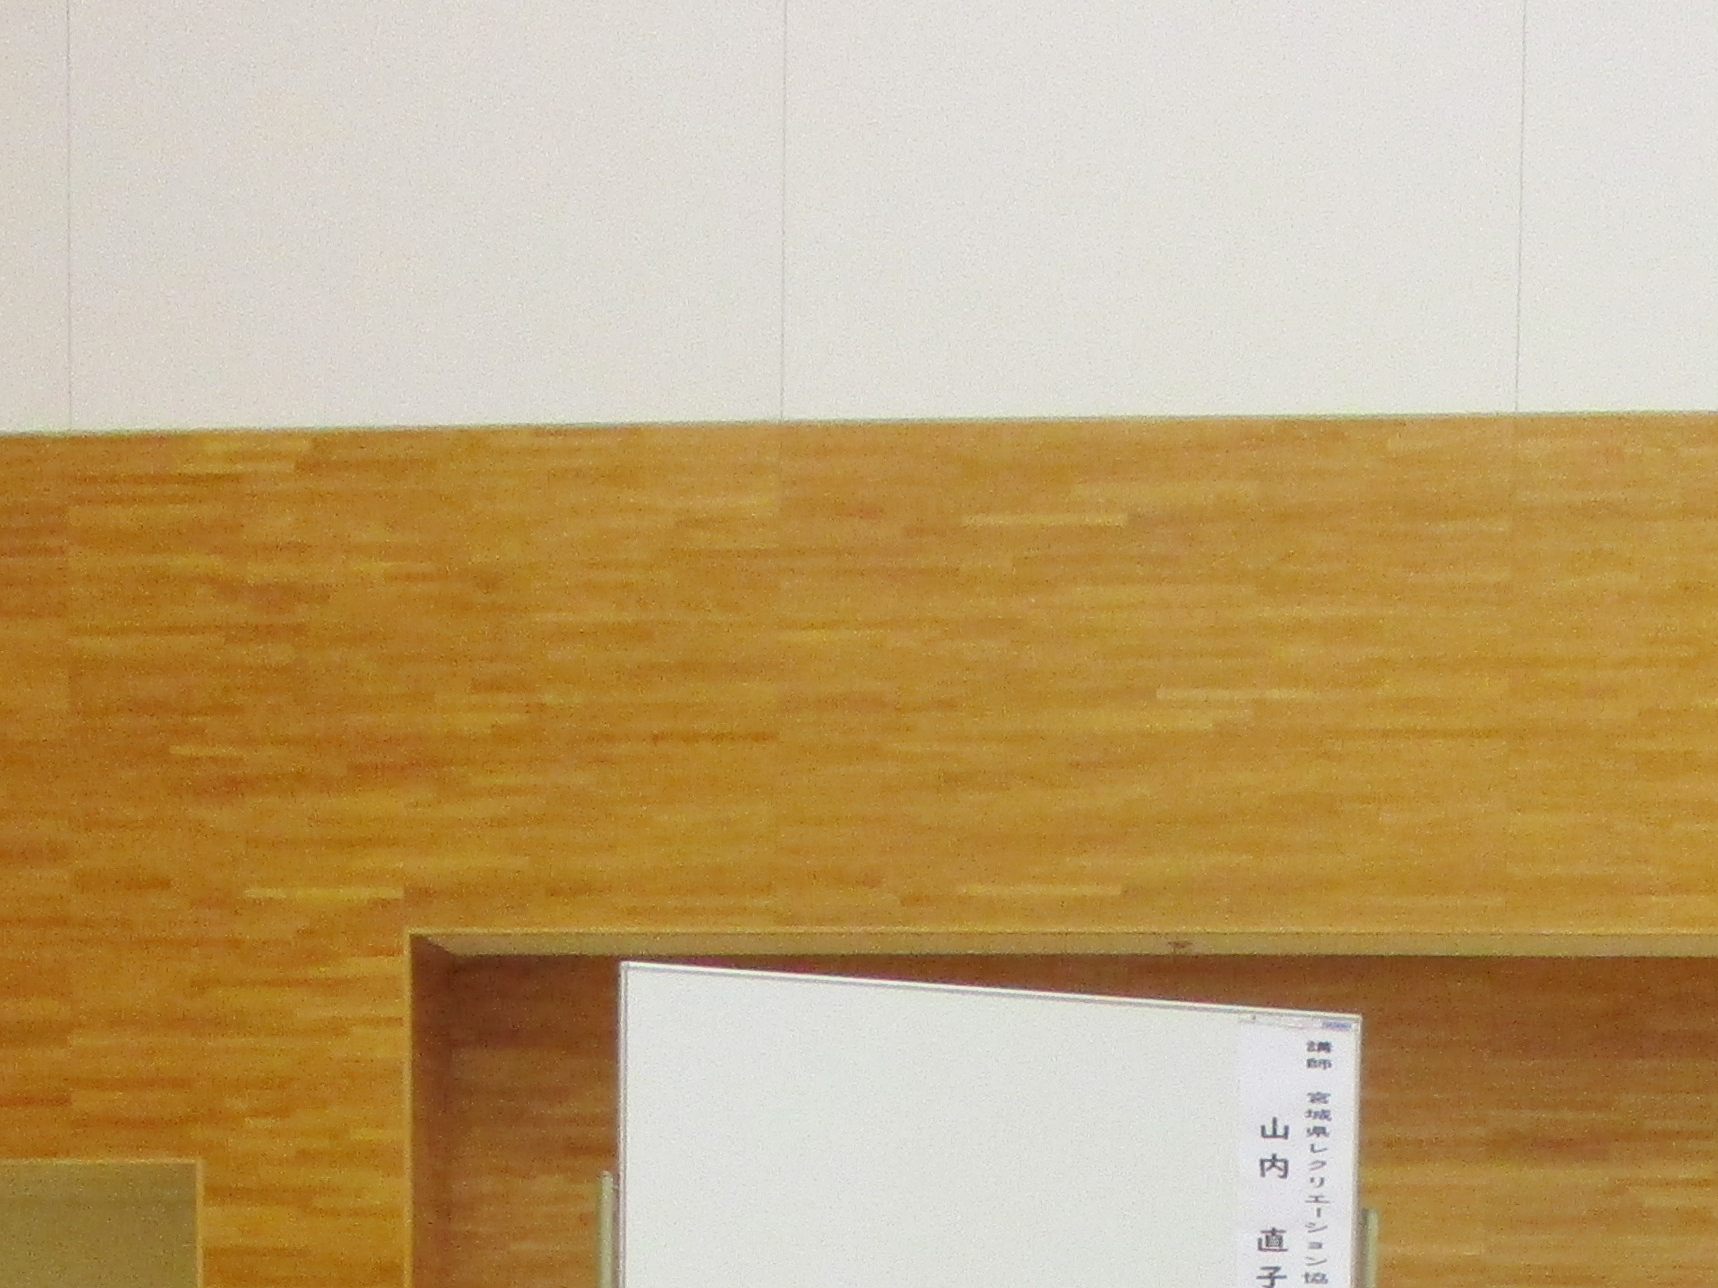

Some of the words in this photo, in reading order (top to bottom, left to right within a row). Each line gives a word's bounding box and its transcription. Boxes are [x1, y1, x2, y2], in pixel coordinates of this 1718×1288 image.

[1306, 1040, 1332, 1069] 講師
[1258, 1117, 1290, 1180] 山内
[1257, 1227, 1288, 1288] 直子
